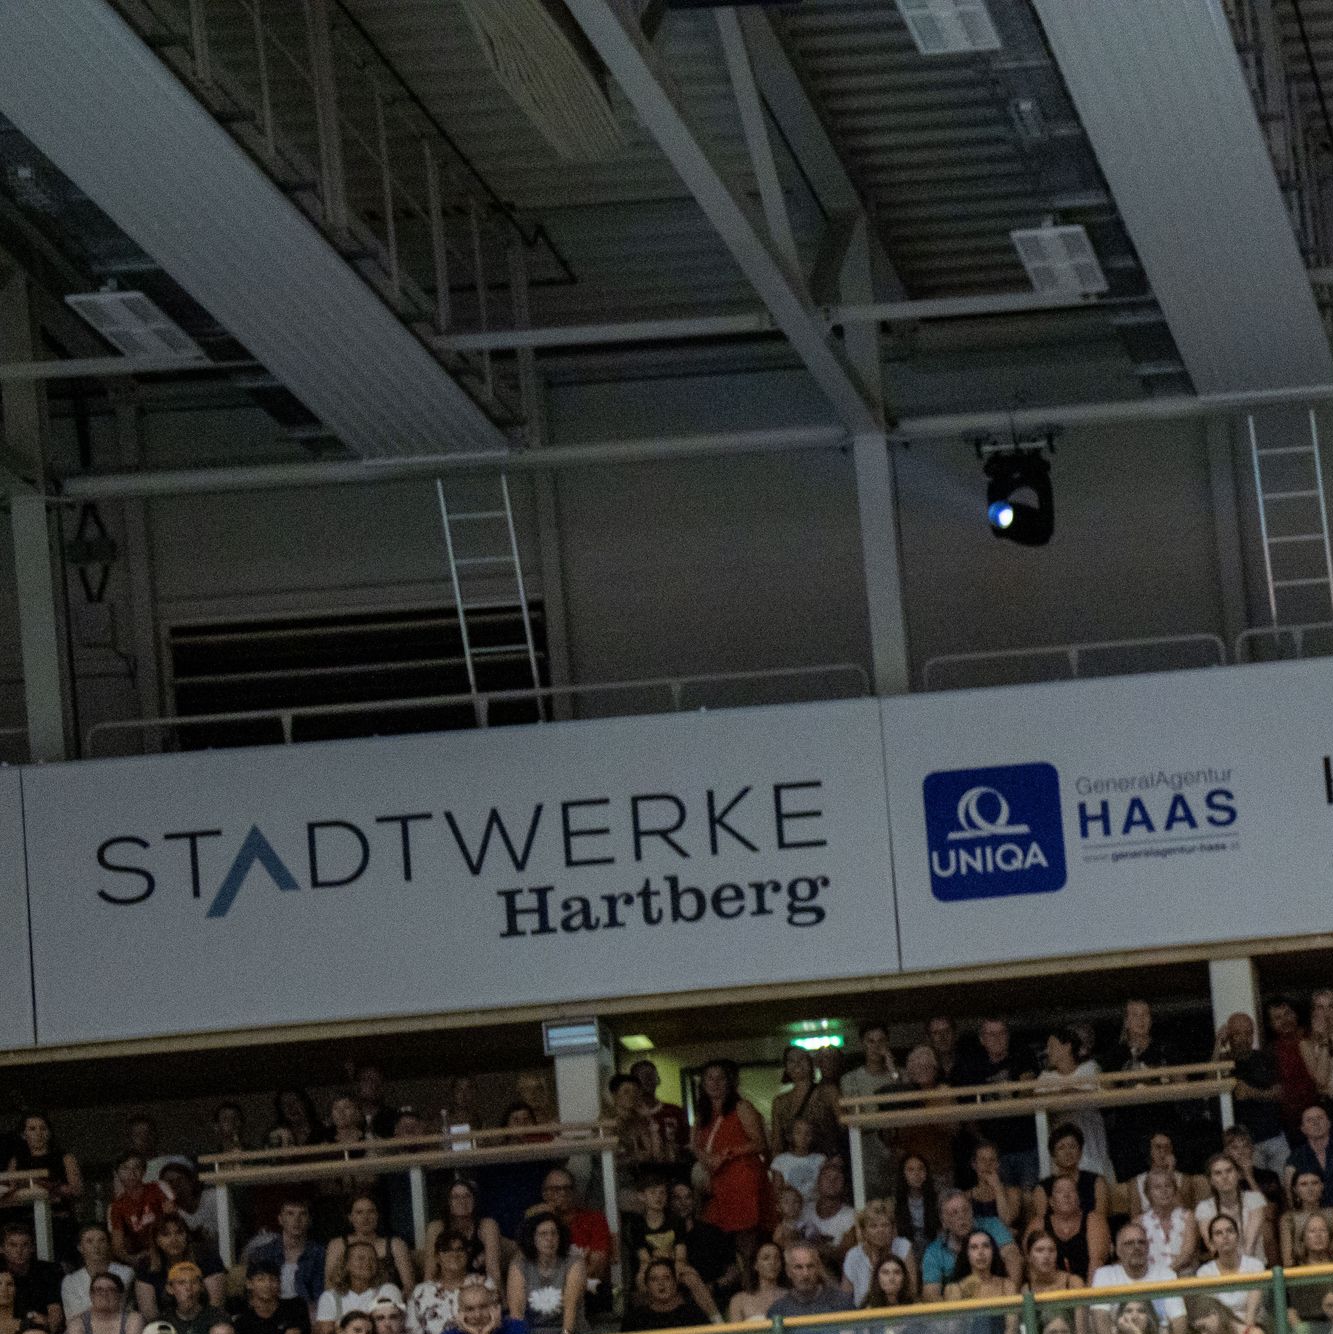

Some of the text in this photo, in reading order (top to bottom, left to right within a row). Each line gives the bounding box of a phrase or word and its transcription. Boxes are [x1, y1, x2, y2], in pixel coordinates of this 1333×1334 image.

[1075, 767, 1233, 797] GeneralAgentur
[1078, 788, 1239, 839] HAAS
[95, 780, 829, 919] STADTWERKE
[931, 841, 1050, 880] UNIQA
[497, 874, 831, 939] Hartberg
